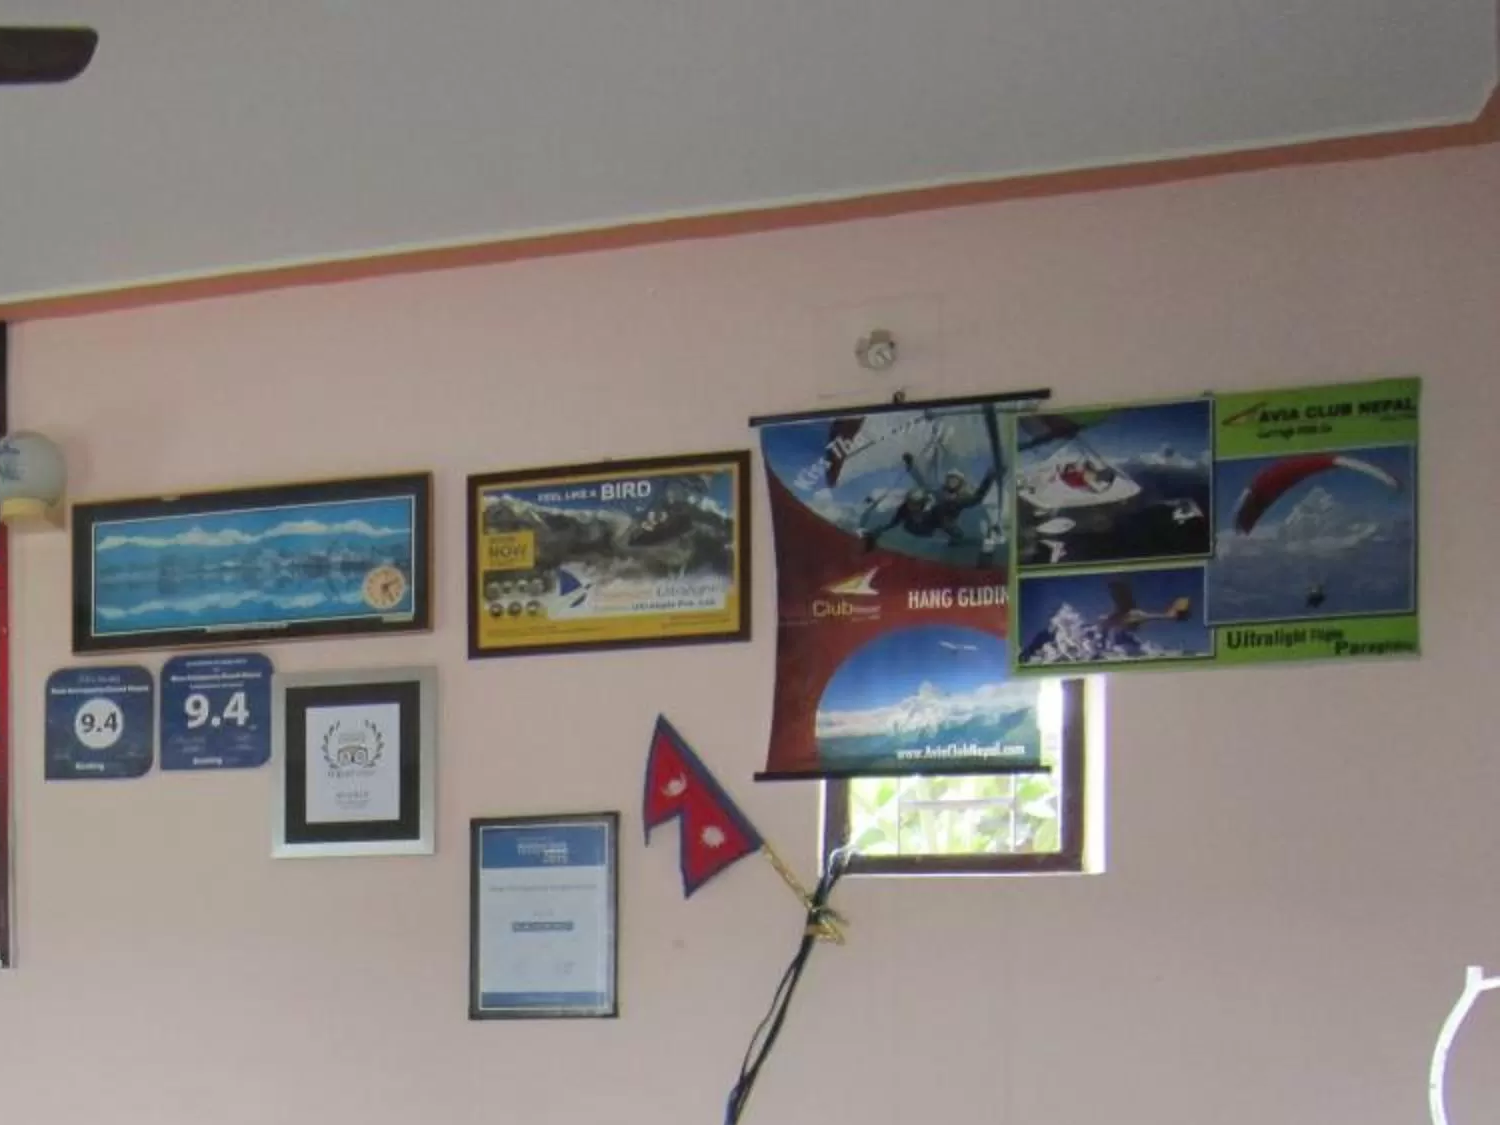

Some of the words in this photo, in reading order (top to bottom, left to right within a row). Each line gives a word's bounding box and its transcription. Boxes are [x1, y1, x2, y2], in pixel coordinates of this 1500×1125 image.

[600, 480, 652, 501] BIRD
[812, 599, 853, 617] Club
[908, 589, 953, 609] HANG
[957, 585, 1009, 607] GLIDIN
[184, 691, 250, 729] 9.4
[81, 711, 118, 733] 9.4
